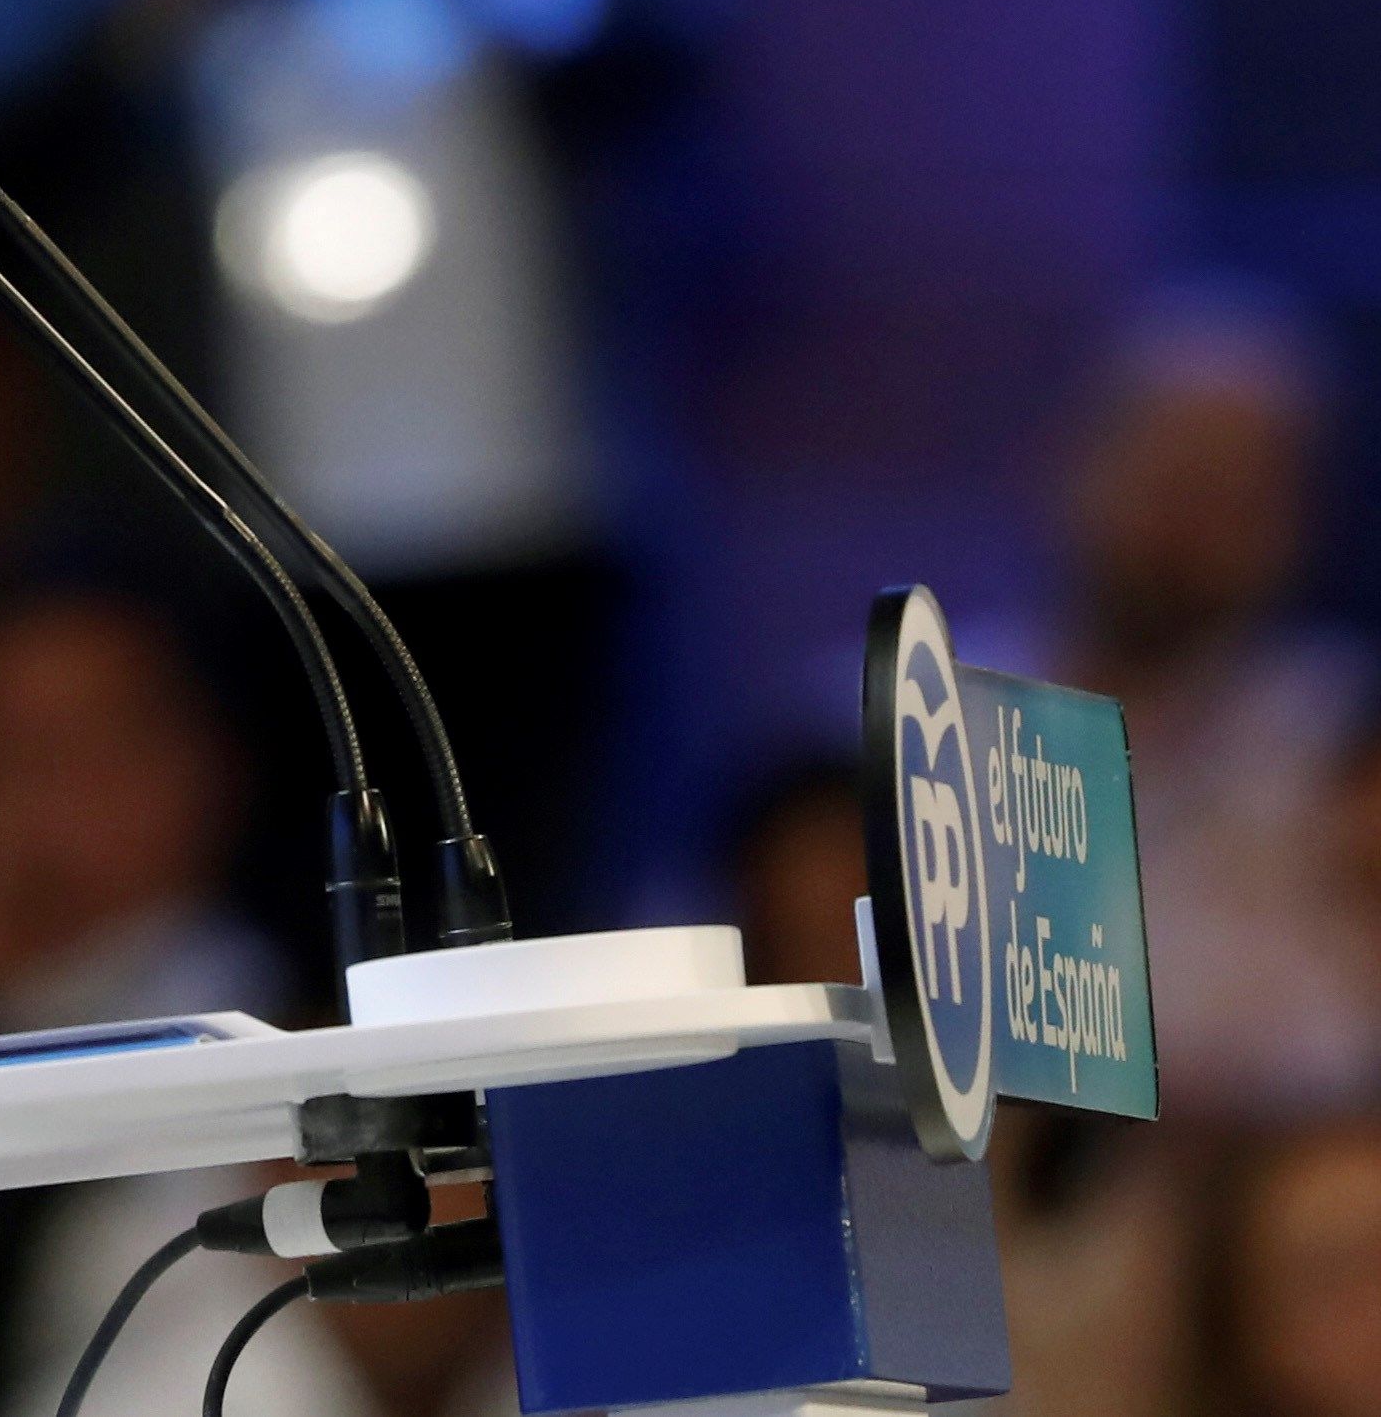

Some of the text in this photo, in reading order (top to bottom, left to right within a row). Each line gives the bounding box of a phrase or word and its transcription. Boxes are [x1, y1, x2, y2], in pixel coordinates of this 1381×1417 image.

[912, 776, 969, 1005] PP
[990, 705, 1086, 893] el futuro
[1006, 900, 1126, 1094] de España
